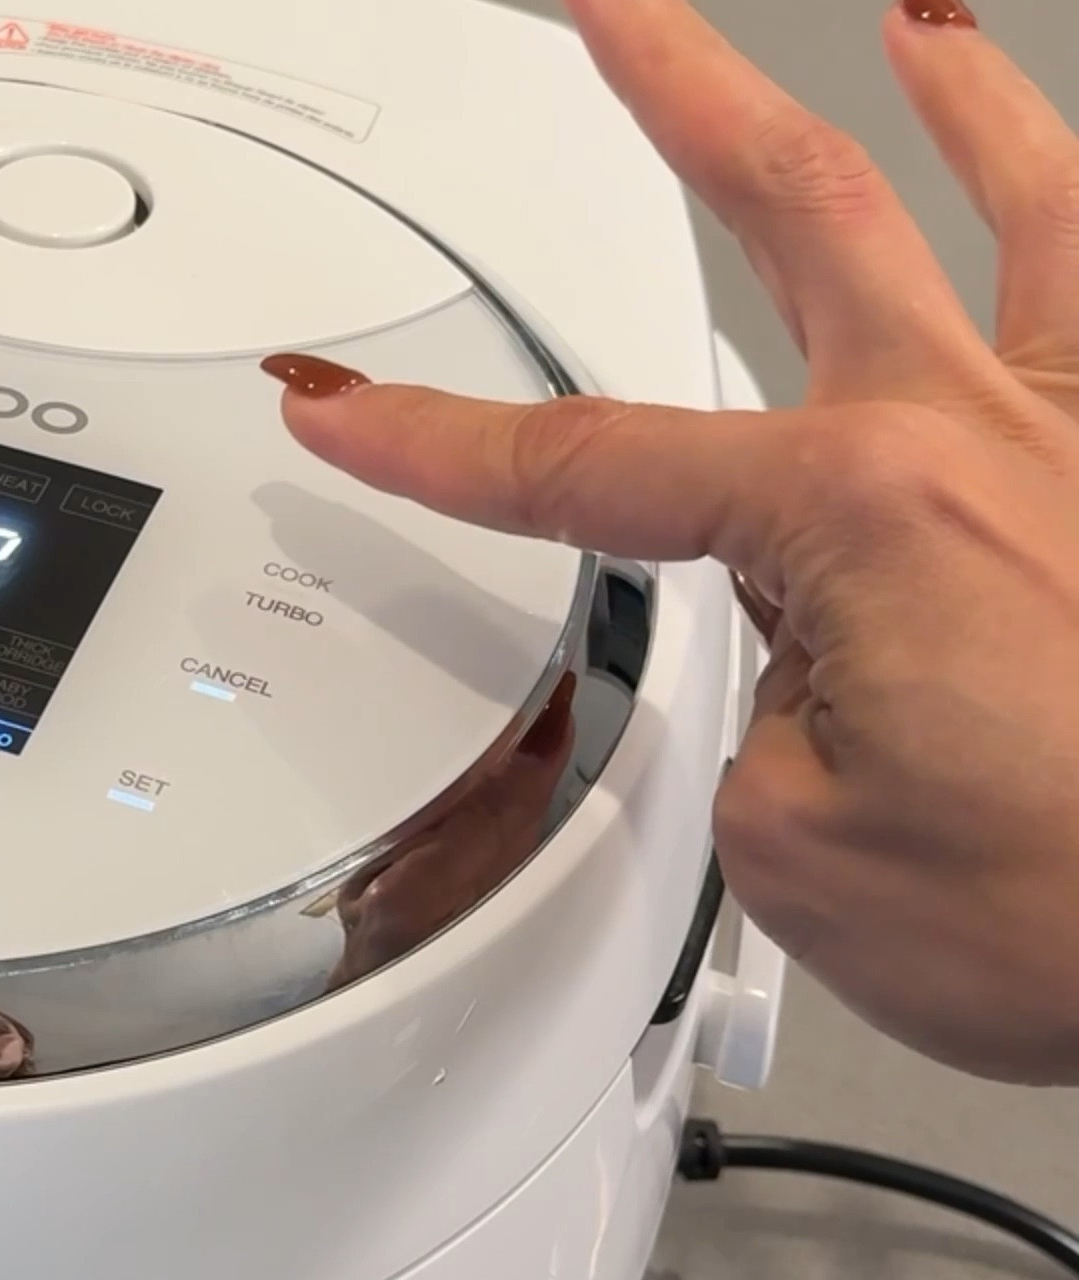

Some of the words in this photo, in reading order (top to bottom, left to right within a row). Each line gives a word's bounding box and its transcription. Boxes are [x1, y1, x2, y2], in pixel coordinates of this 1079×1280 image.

[81, 496, 136, 522] LOCK
[262, 561, 335, 594] COOK
[244, 591, 325, 627] TURBO
[180, 656, 273, 699] CANCEL
[118, 769, 170, 797] SET
